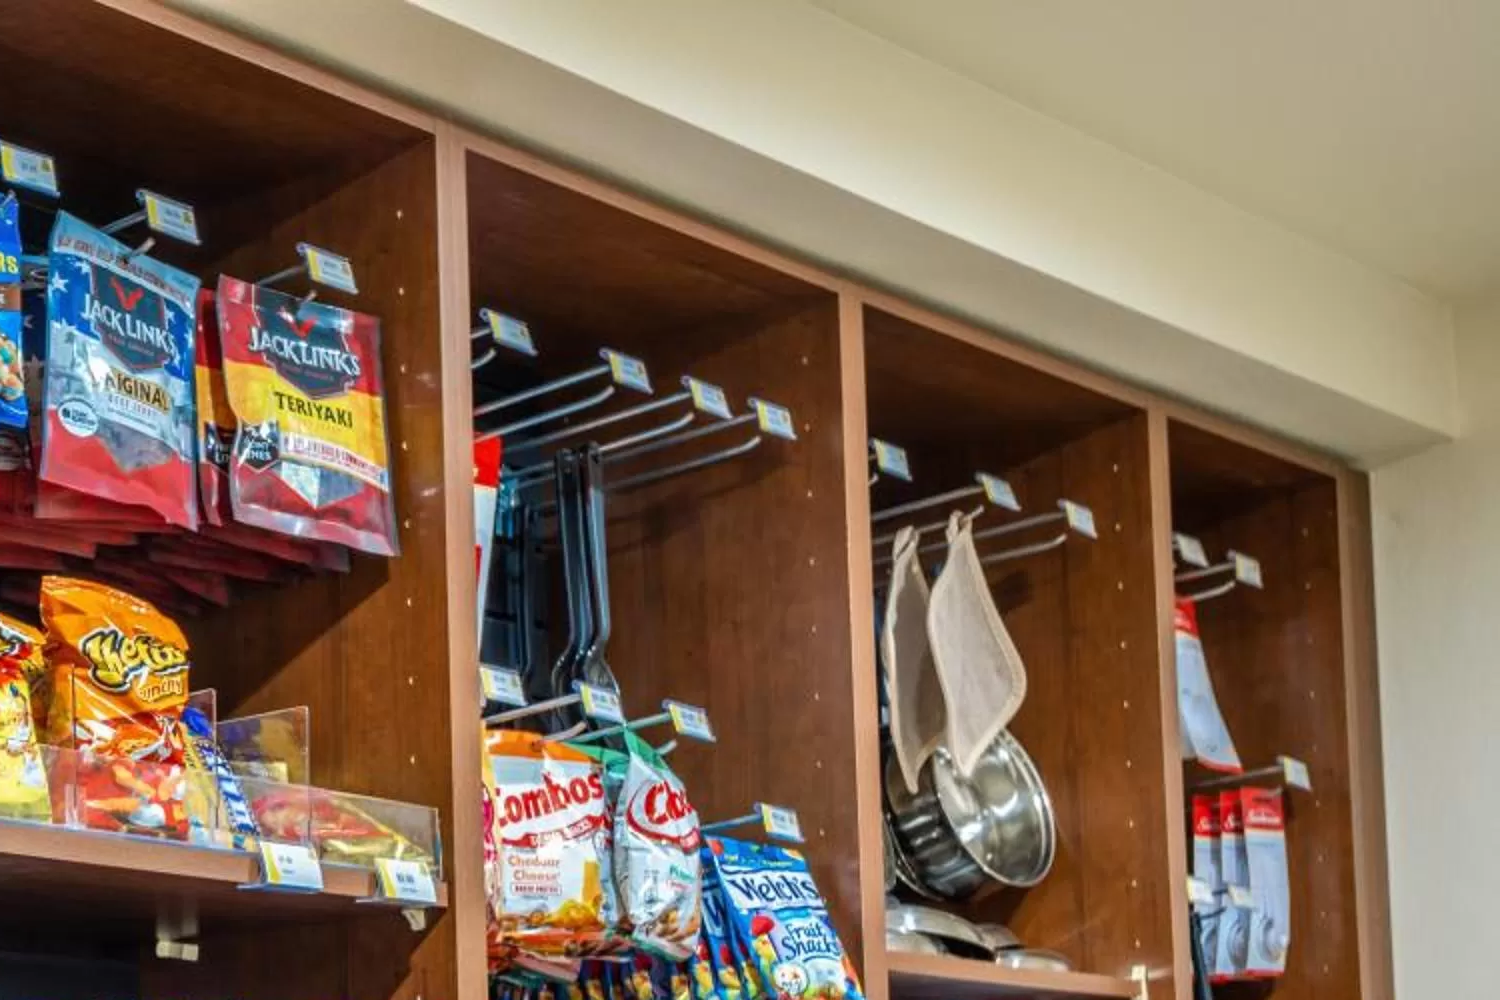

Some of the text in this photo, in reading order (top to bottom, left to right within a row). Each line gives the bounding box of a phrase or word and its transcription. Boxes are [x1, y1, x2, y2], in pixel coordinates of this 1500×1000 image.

[82, 293, 124, 334] JACK
[248, 326, 298, 358] JACK
[104, 369, 170, 413] IGINAL
[274, 390, 353, 428] TERIYAKI
[727, 874, 820, 903] Welch's
[784, 921, 823, 940] Fruit
[781, 933, 842, 962] Snacks
